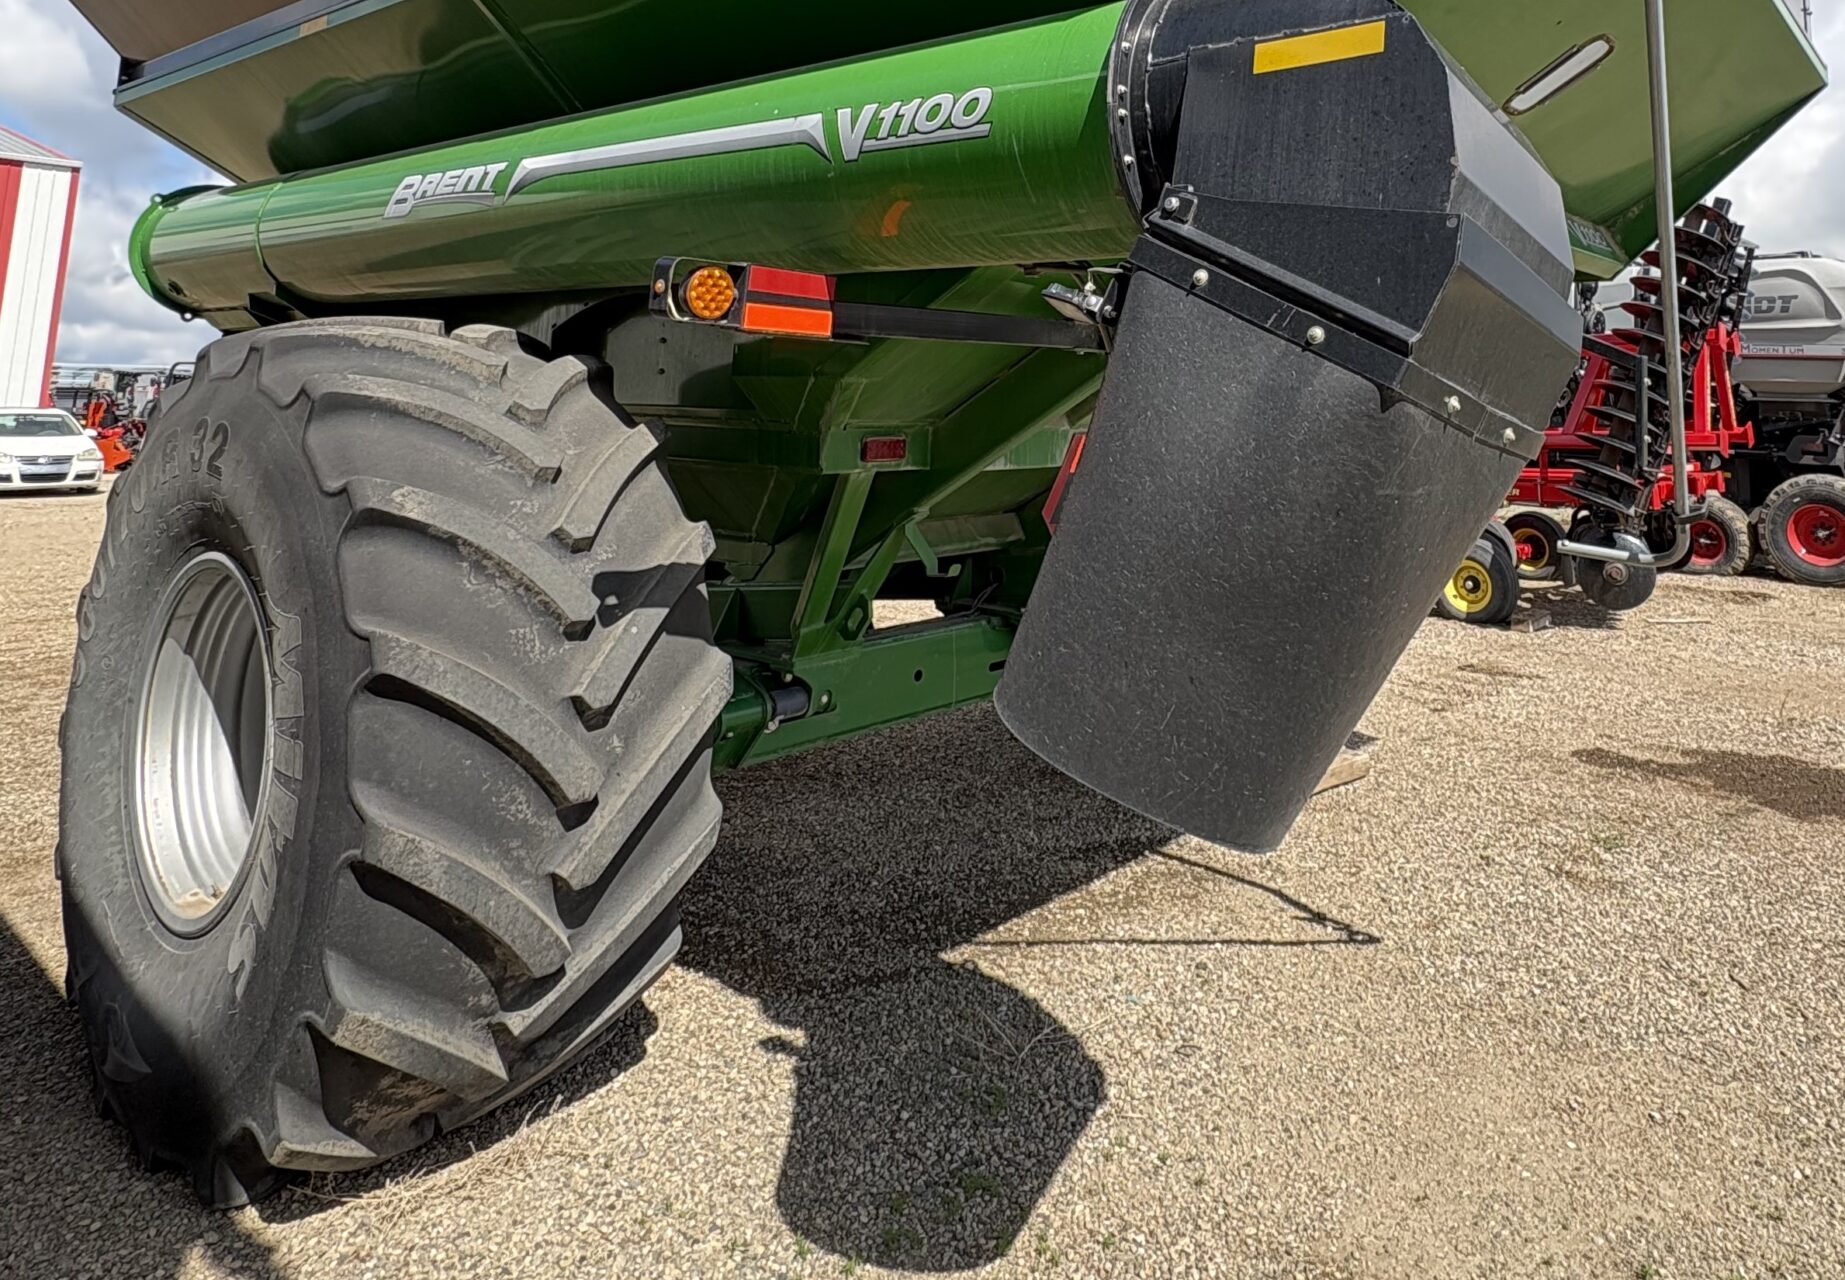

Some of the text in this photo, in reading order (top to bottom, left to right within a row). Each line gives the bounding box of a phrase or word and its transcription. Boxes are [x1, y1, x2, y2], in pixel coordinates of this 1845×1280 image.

[836, 86, 993, 163] V1100
[383, 161, 508, 219] BRENT
[189, 416, 231, 481] 32
